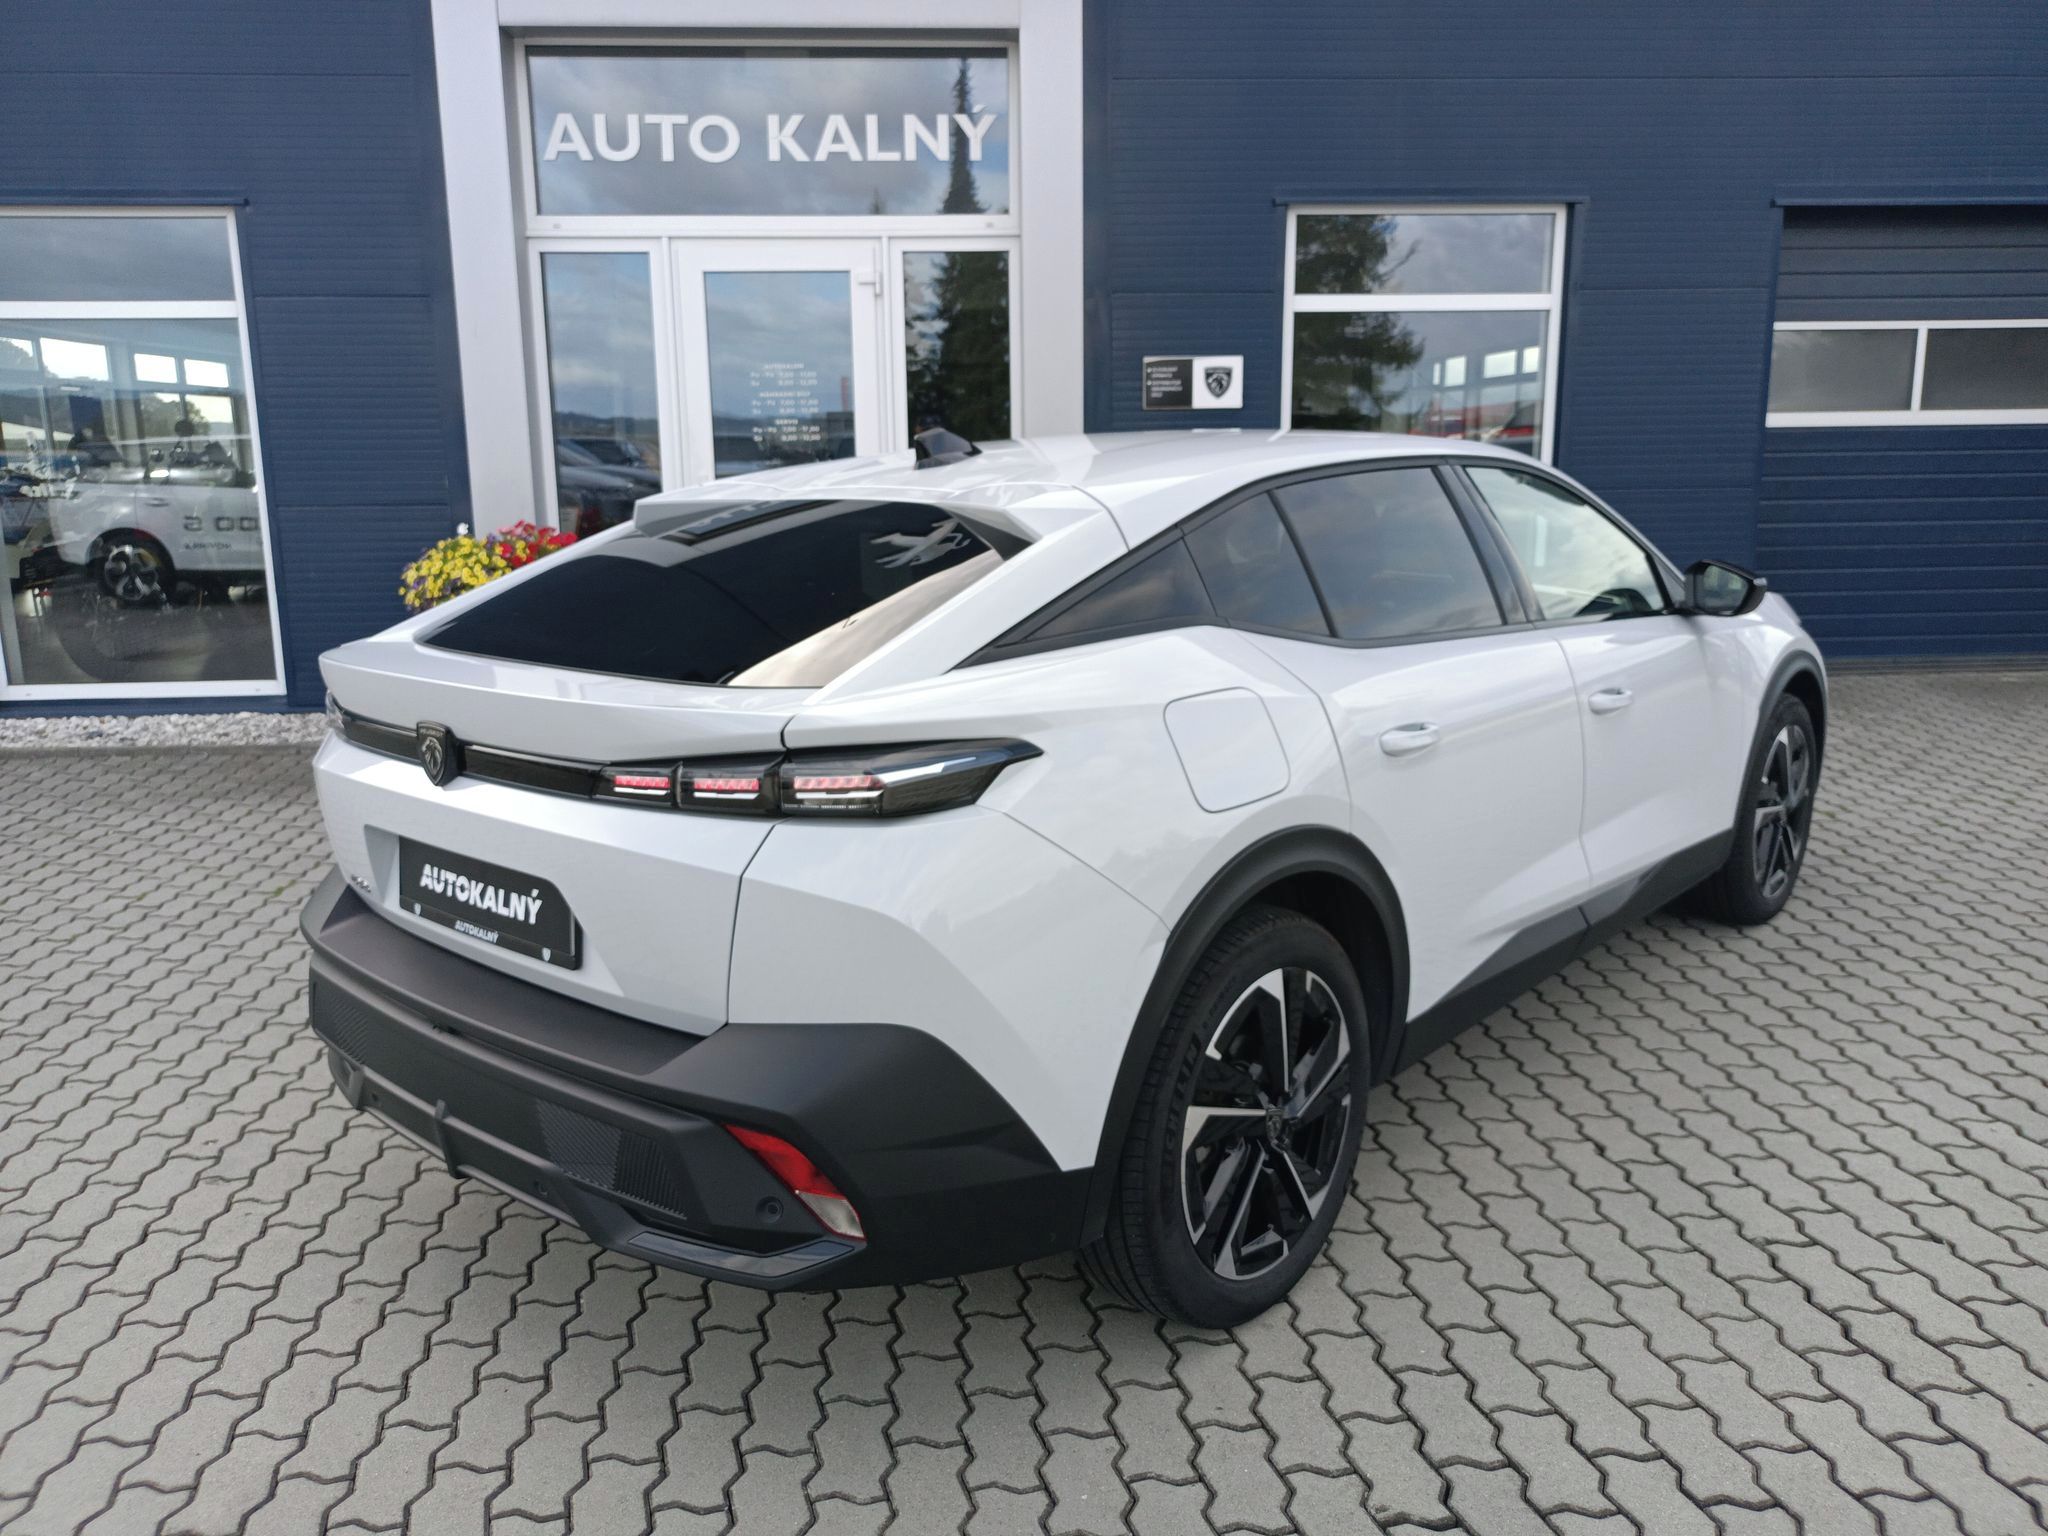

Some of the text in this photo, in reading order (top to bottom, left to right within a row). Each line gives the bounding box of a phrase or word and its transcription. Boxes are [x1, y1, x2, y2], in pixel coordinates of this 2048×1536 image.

[543, 103, 997, 163] AUTO KALNÝ
[419, 863, 544, 926] AUTOKALNÝ
[454, 919, 499, 945] AUTOKALNÝ
